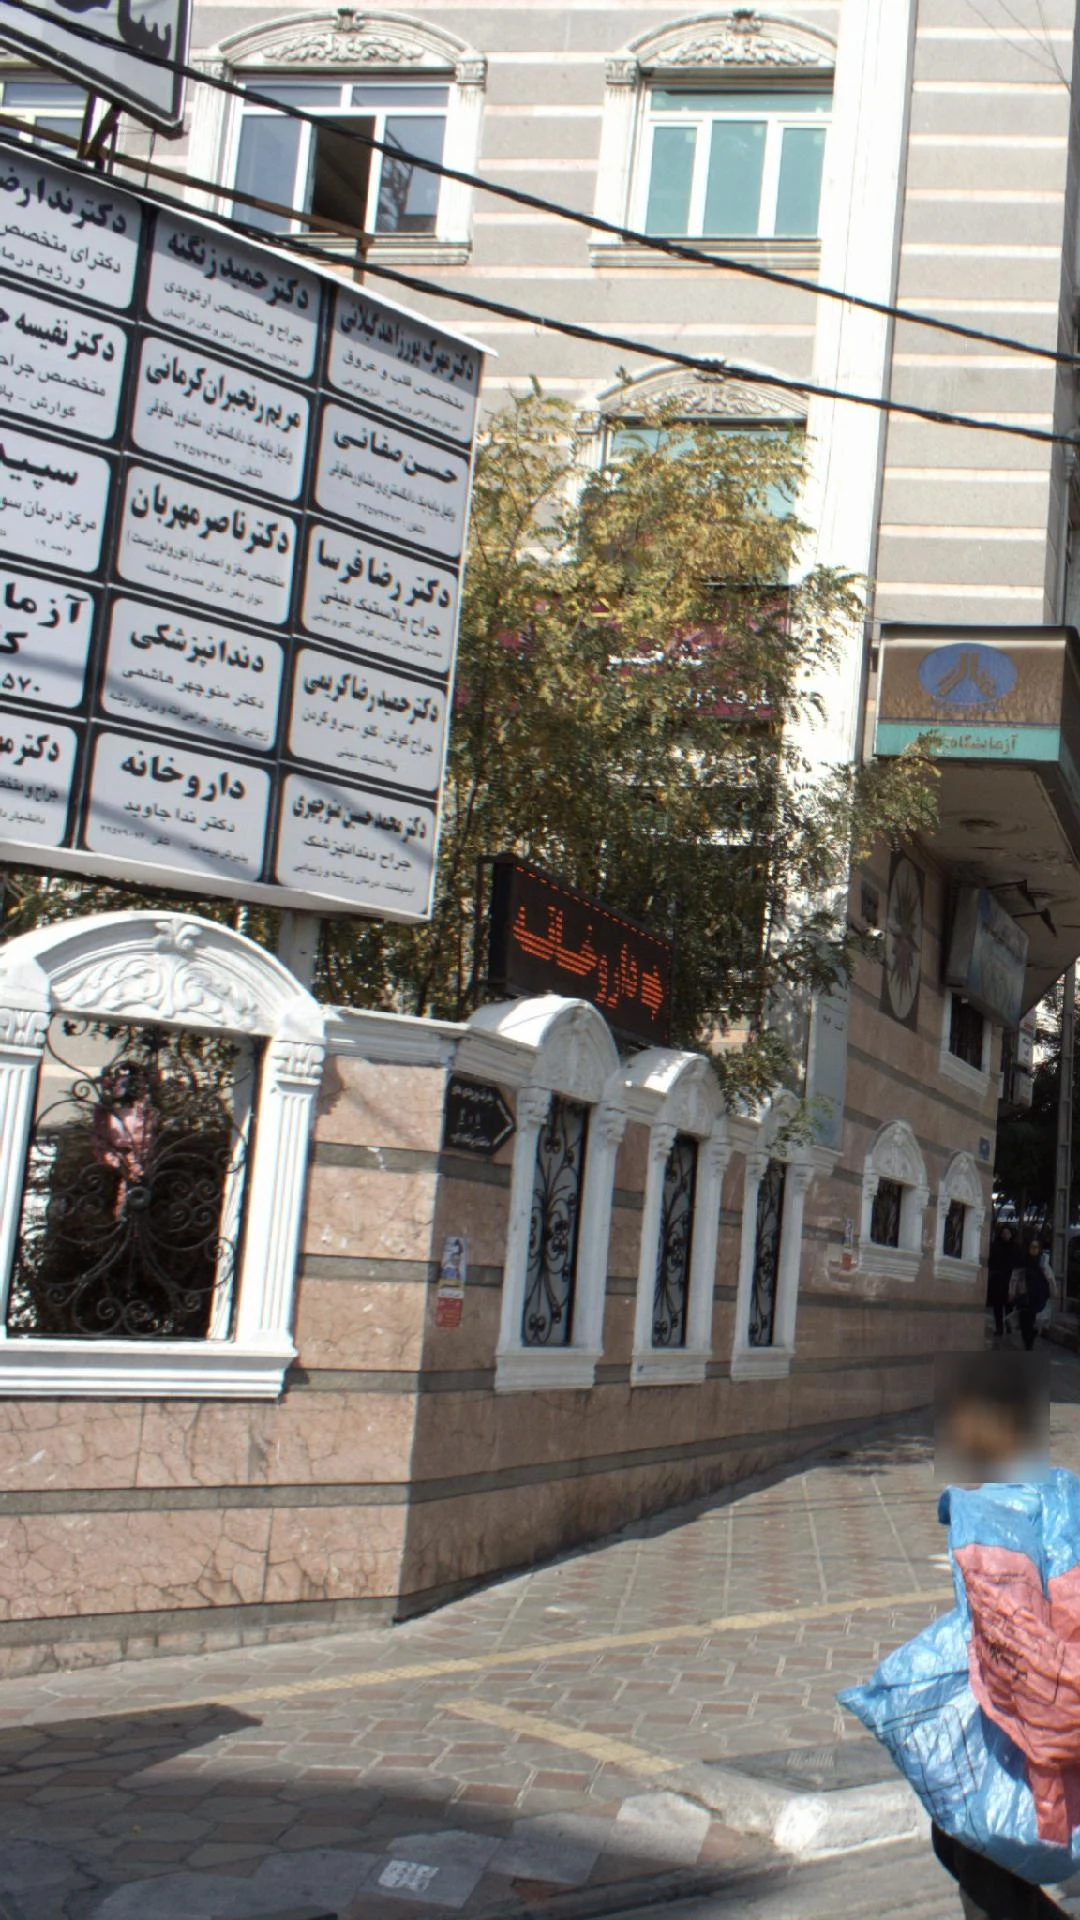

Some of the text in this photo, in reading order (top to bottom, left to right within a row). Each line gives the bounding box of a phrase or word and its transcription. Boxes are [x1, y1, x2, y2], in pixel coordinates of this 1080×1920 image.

[0, 166, 127, 234] دکتر ندا رض
[1, 246, 34, 268] درما
[71, 247, 121, 274] دکترای
[37, 262, 72, 285] رژیم
[220, 258, 268, 290] حمید
[163, 282, 212, 309] ارتوپدی
[265, 278, 309, 310] دکتر
[15, 312, 68, 350] نفیسه
[213, 304, 265, 327] متخصص
[67, 330, 114, 361] دکتر
[276, 327, 304, 347] جراح
[38, 372, 106, 397] متخصص
[145, 353, 301, 434] مریم رنجبران کرمانی
[413, 387, 465, 411] متخصص
[30, 397, 76, 419] گوارش
[403, 455, 458, 484] حسن
[24, 501, 63, 525] درمان
[65, 510, 97, 533] مرکز
[130, 483, 290, 555] دکتر ناصر مهربان
[247, 573, 285, 589] متخصص
[367, 557, 402, 602] رضا
[404, 576, 451, 609] دکتر
[5, 582, 89, 630] آزما
[320, 587, 441, 640] جراح پلاستیک بینی
[129, 623, 265, 673] دندانپزشکی
[121, 668, 265, 710] دکتر منوچهر هاشمی
[408, 697, 439, 726] دکتر
[14, 734, 60, 767] دکتر
[120, 750, 246, 803] داروخانه
[123, 801, 236, 833] دکتر ندا جاوید
[400, 816, 427, 845] دکتر
[303, 835, 412, 872] جراح دندانپزشک
